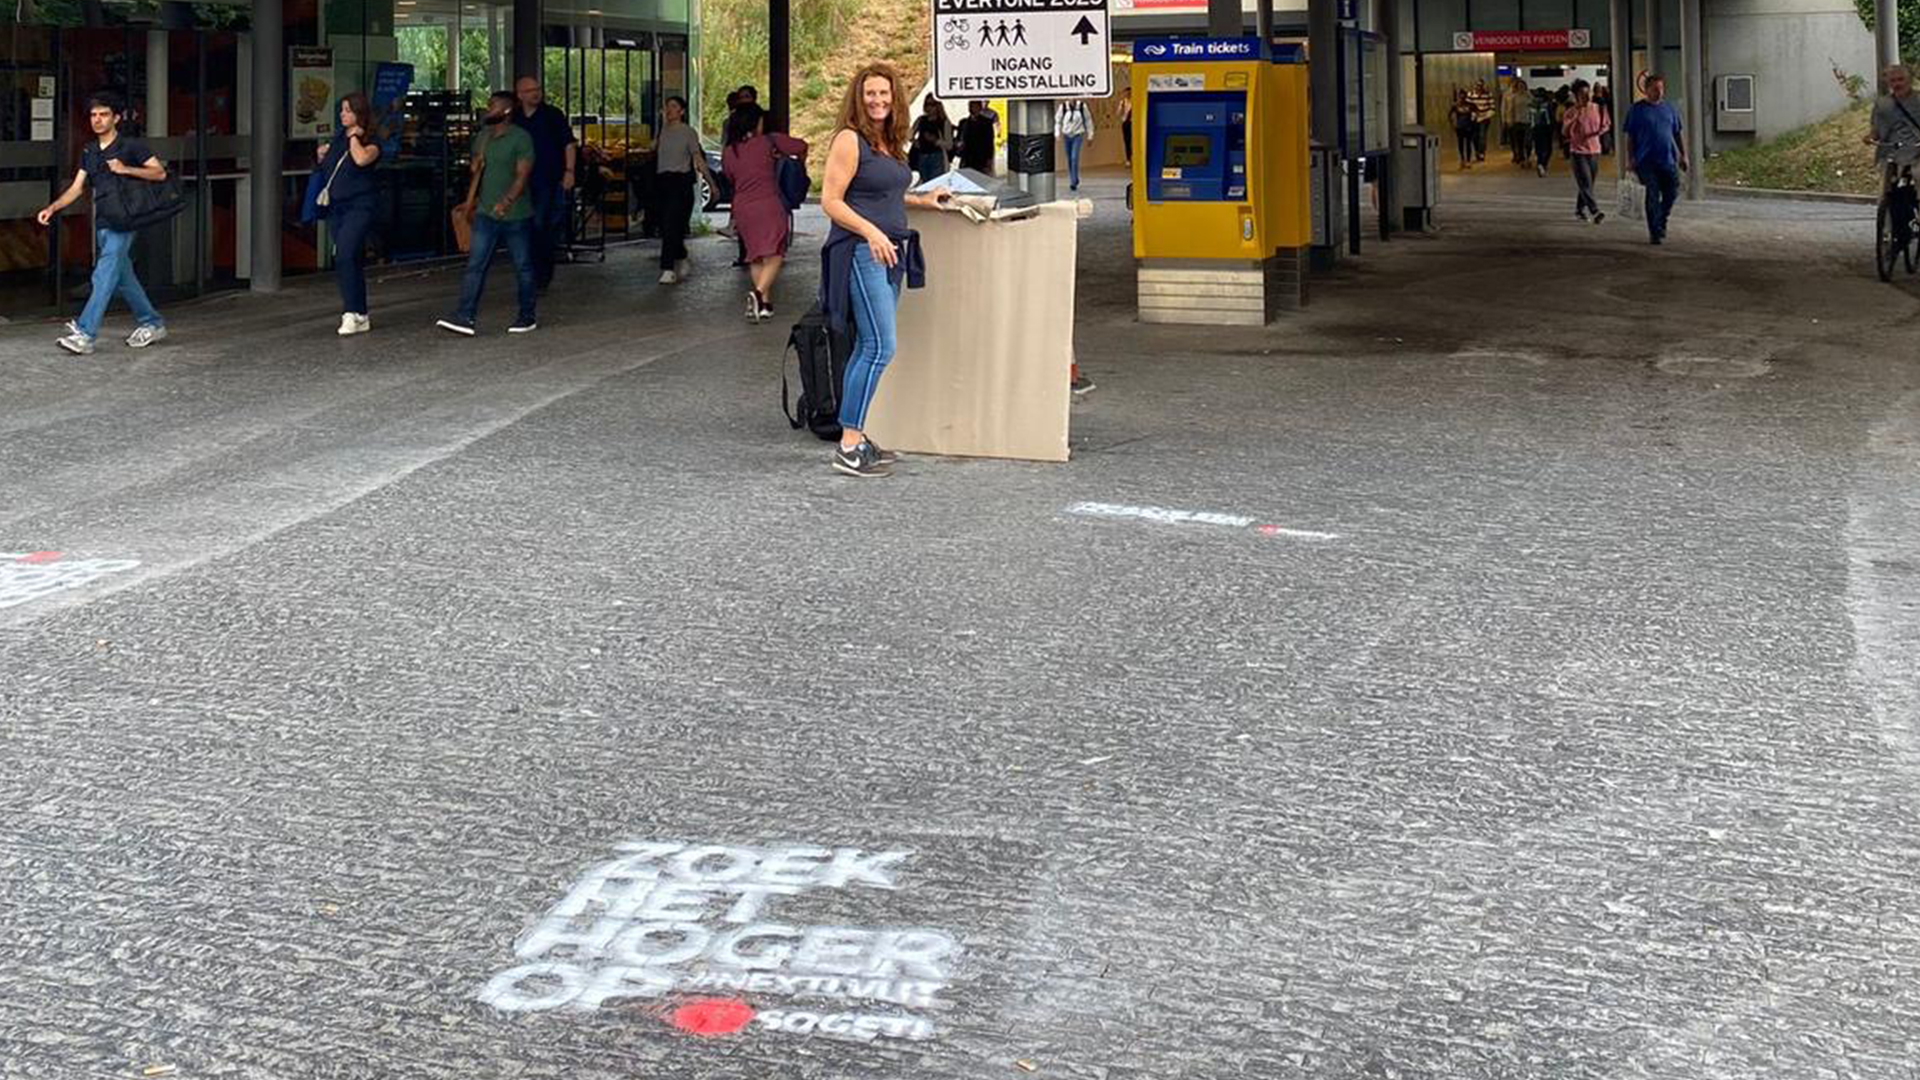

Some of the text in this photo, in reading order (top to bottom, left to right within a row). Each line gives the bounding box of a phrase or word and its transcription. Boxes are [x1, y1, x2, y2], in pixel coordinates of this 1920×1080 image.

[991, 57, 1053, 71] INGANG
[1171, 41, 1250, 55] Train tickets
[949, 73, 1096, 90] FIETSENSTALLING
[598, 840, 914, 889] ZOEK
[554, 872, 805, 922] HET
[513, 916, 965, 980] HOGER
[477, 962, 680, 1012] OP
[754, 1009, 937, 1042] SOGETI
